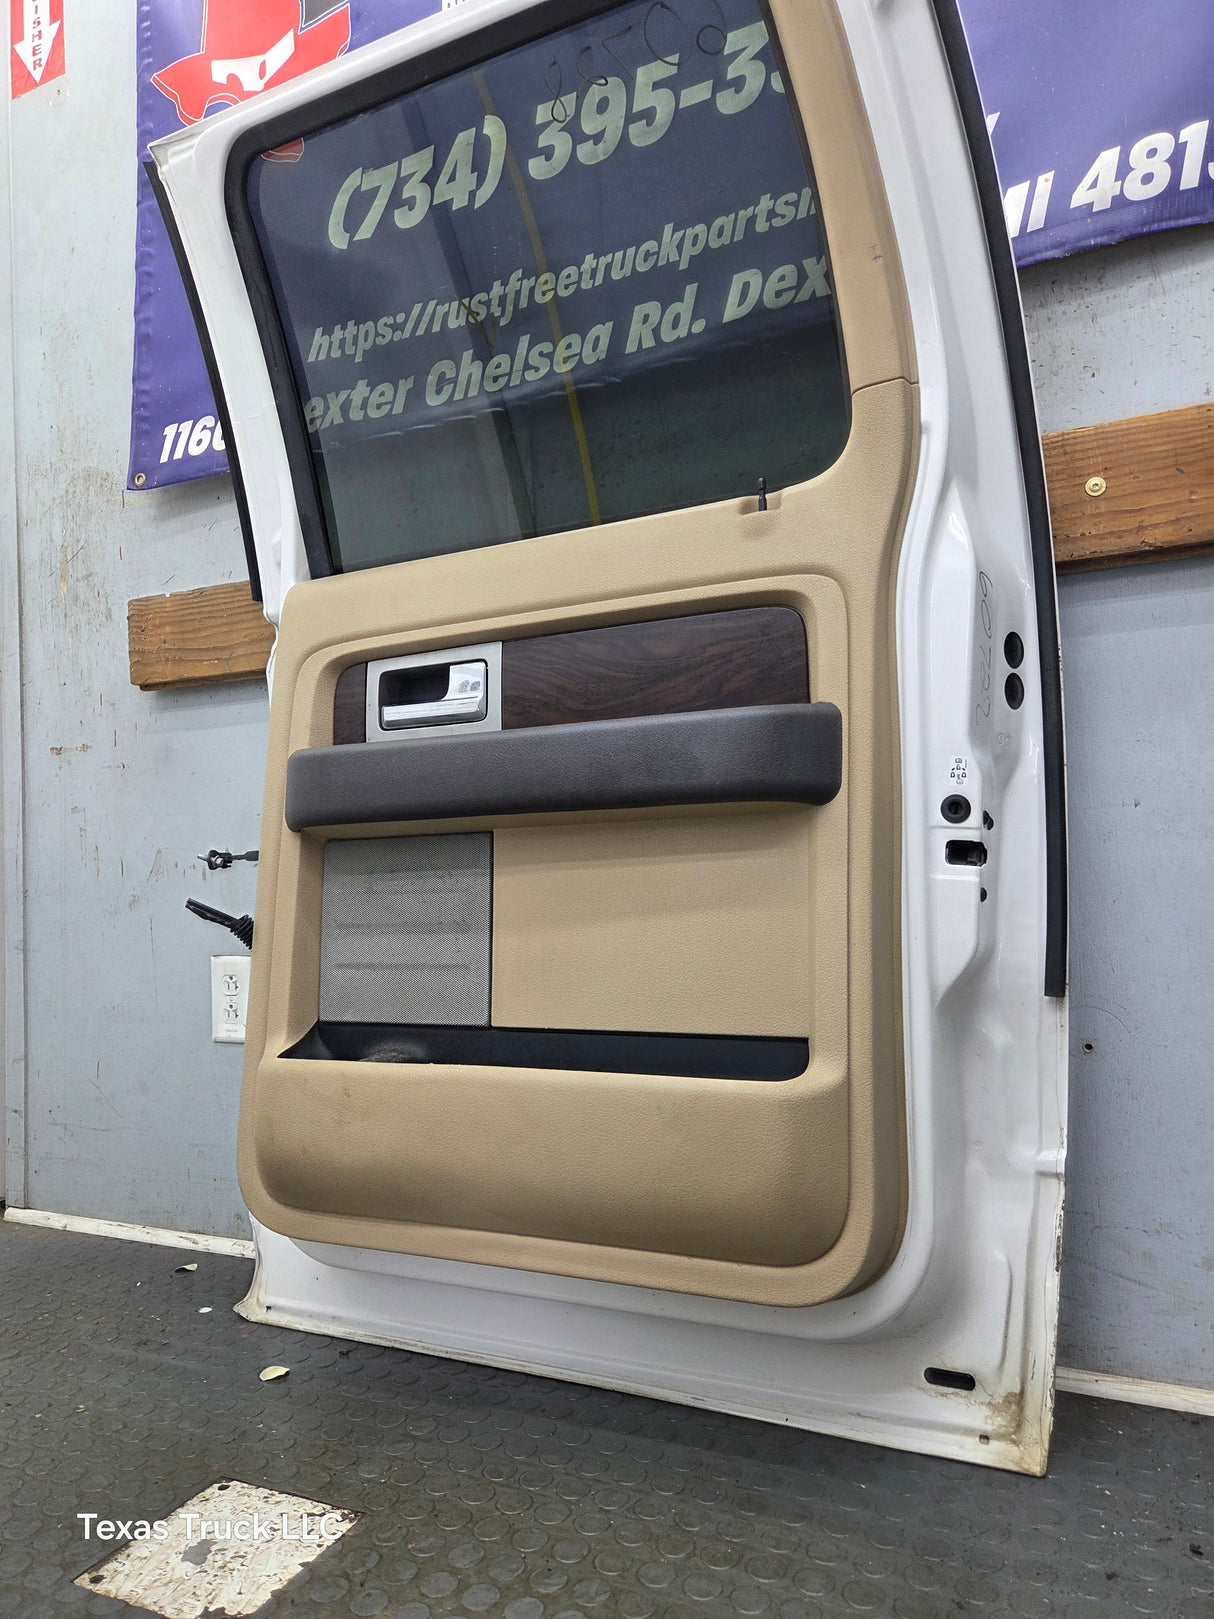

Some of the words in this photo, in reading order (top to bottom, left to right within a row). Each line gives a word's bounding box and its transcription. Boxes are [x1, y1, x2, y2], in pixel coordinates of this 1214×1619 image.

[31, 0, 43, 71] ISHER
[328, 114, 507, 250] (734)
[425, 321, 614, 407] Chelsea
[625, 283, 706, 354] Rd.
[723, 254, 832, 324] Dex
[1070, 119, 1214, 213] 481
